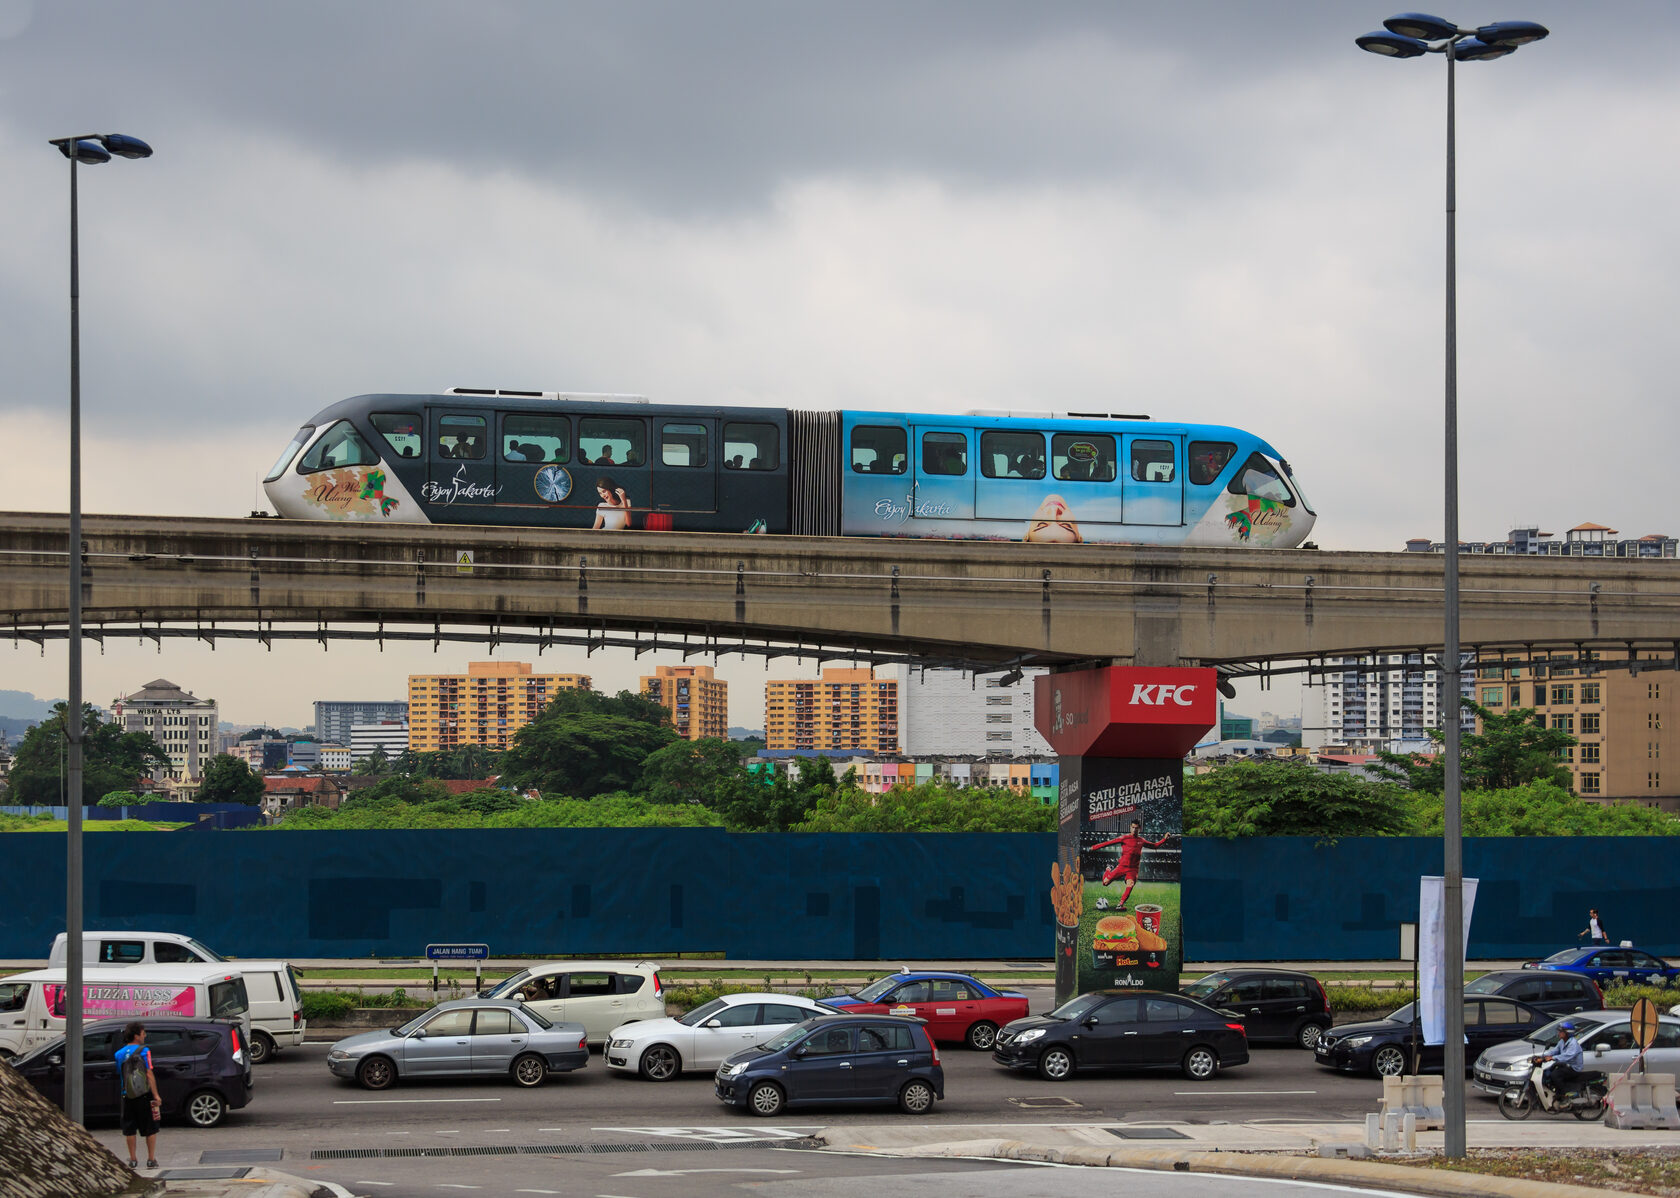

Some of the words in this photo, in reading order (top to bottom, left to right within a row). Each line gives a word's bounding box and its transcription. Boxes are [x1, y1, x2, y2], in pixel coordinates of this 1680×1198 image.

[314, 484, 353, 509] Udang
[1251, 510, 1283, 534] Udang
[1128, 683, 1197, 706] KFC
[1089, 787, 1116, 803] SATU
[1118, 782, 1141, 797] CITA
[1144, 775, 1172, 791] RASA
[1089, 797, 1116, 814] SATU
[1118, 785, 1175, 808] SEMANGAT
[1114, 975, 1144, 986] RONALDO
[87, 987, 130, 1000] LIZZA
[133, 988, 173, 1001] NASS
